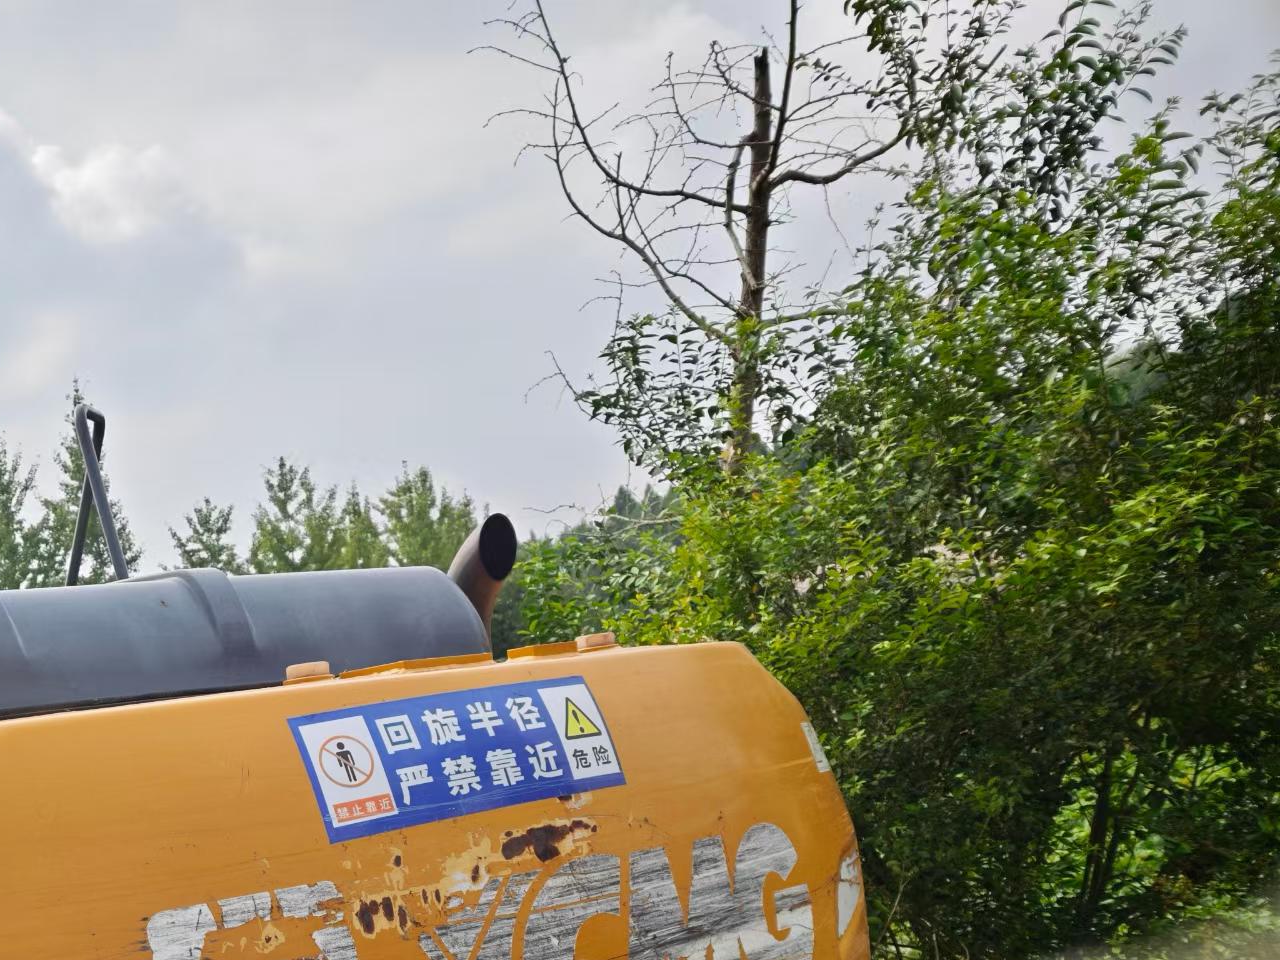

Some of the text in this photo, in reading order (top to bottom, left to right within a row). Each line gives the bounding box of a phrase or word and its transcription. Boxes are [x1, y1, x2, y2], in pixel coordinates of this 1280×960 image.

[375, 696, 546, 754] 回旋半径
[396, 741, 563, 805] 严禁靠近
[573, 745, 612, 770] 危险
[337, 797, 392, 819] 禁止靠近
